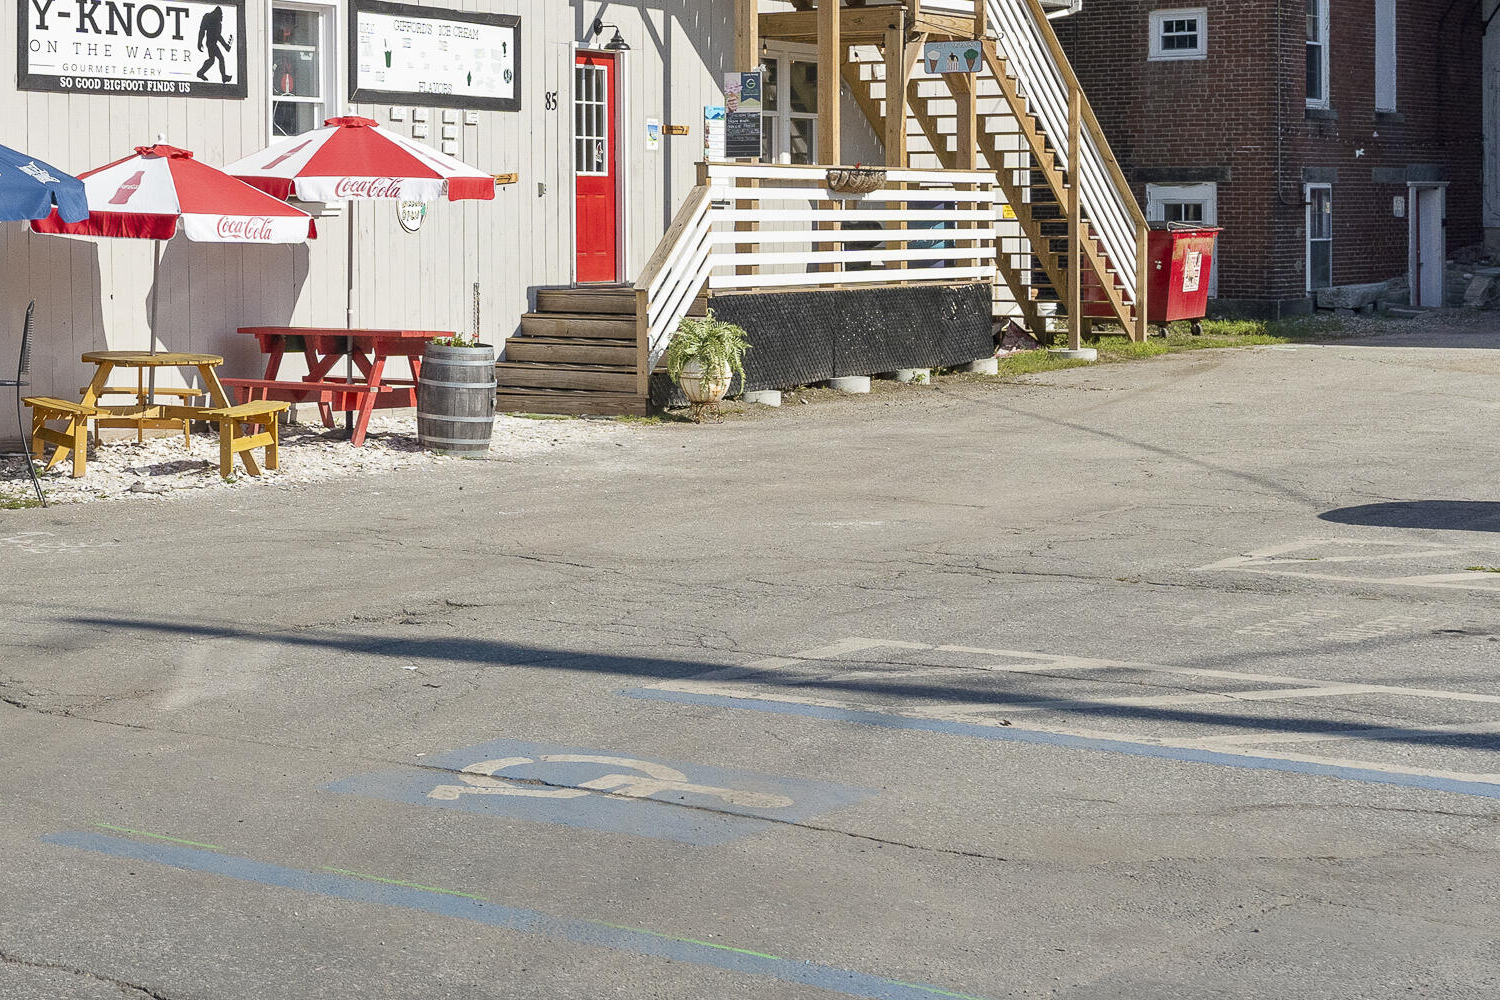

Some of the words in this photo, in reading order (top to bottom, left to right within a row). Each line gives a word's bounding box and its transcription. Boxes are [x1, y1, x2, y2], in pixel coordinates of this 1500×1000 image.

[438, 25, 451, 37] ICE
[453, 26, 479, 40] CREAM
[29, 39, 58, 53] ON
[73, 42, 112, 57] THE
[125, 45, 192, 62] WATER
[62, 63, 117, 74] GOURMET
[123, 66, 163, 76] EATERY
[60, 76, 73, 88] SO
[75, 78, 101, 90] GOOD
[104, 79, 146, 92] BIGFOOT
[147, 81, 176, 93] FINDS
[178, 82, 191, 93] US
[545, 91, 558, 111] 85
[335, 176, 404, 199] Coca-Cola
[216, 215, 275, 240] Coca-Cola
